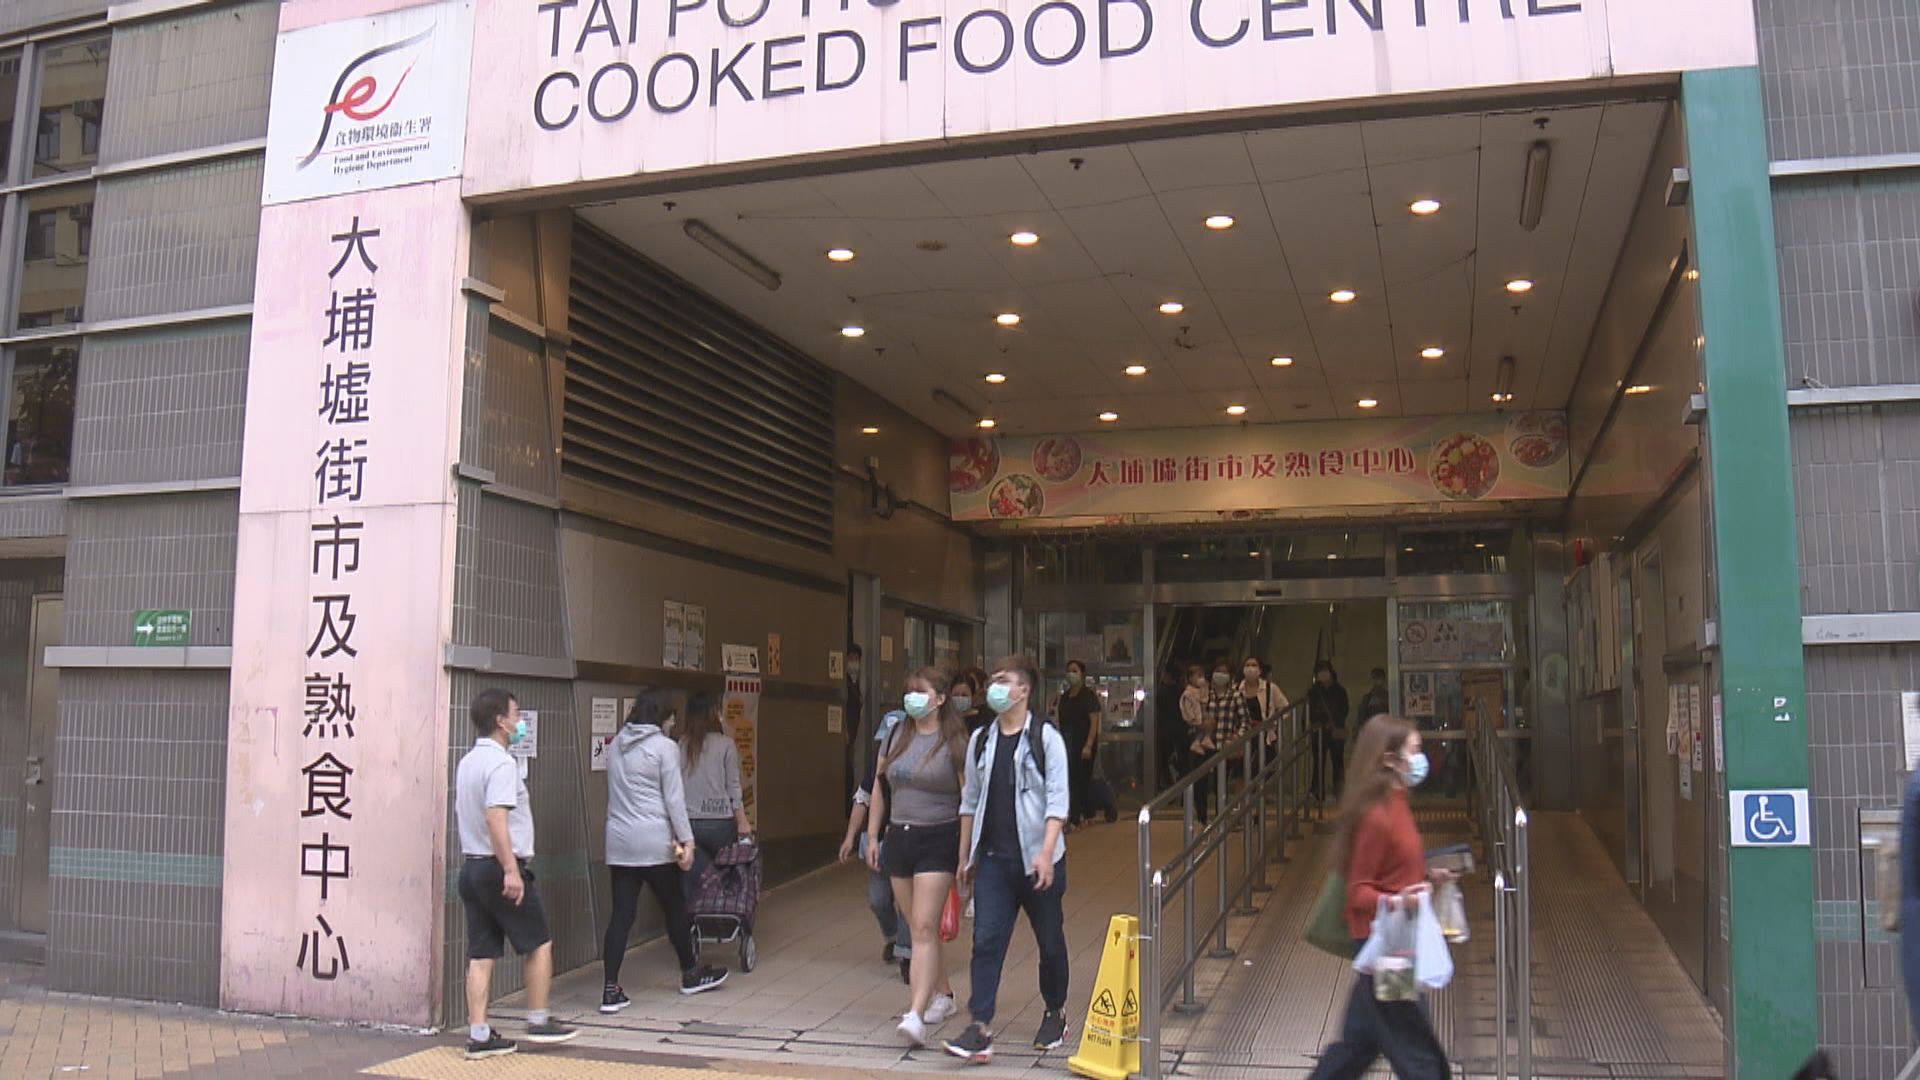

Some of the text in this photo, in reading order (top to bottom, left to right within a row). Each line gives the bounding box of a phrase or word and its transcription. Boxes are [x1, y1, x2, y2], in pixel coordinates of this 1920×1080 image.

[538, 0, 639, 57] TAI
[534, 29, 867, 131] COOKED
[899, 0, 1153, 81] FOOD
[333, 155, 413, 175] Hygiene Department
[334, 141, 431, 165] Food and Environmental
[1088, 447, 1416, 486] 大埔墟街市及熟食中心
[297, 216, 381, 981] 大埔墟街市及熟食中心
